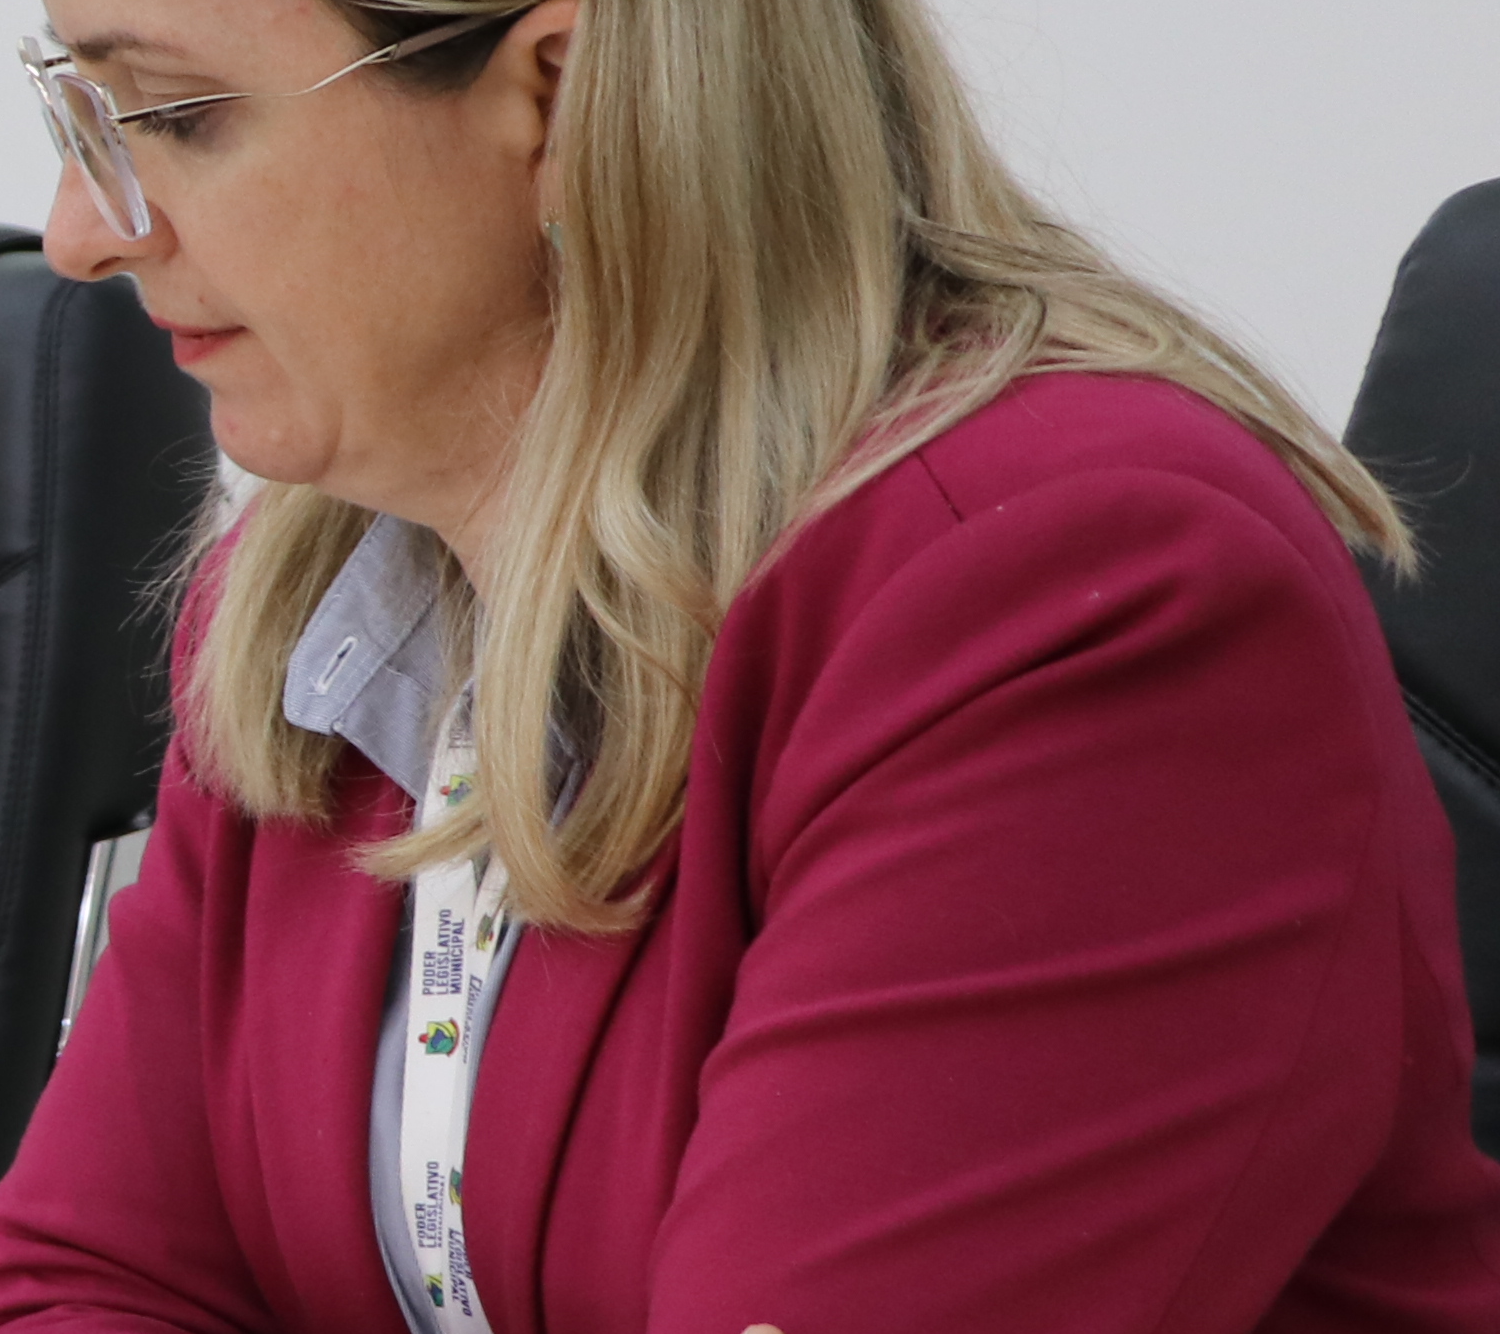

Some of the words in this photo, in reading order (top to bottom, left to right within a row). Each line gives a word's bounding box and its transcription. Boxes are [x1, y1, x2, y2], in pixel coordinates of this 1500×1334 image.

[422, 950, 437, 996] PODER
[436, 909, 452, 996] LEGISLATIVO
[450, 918, 465, 995] MUNICIPAL
[415, 1203, 427, 1249] PODER
[426, 1161, 439, 1249] LEGISLATIVO
